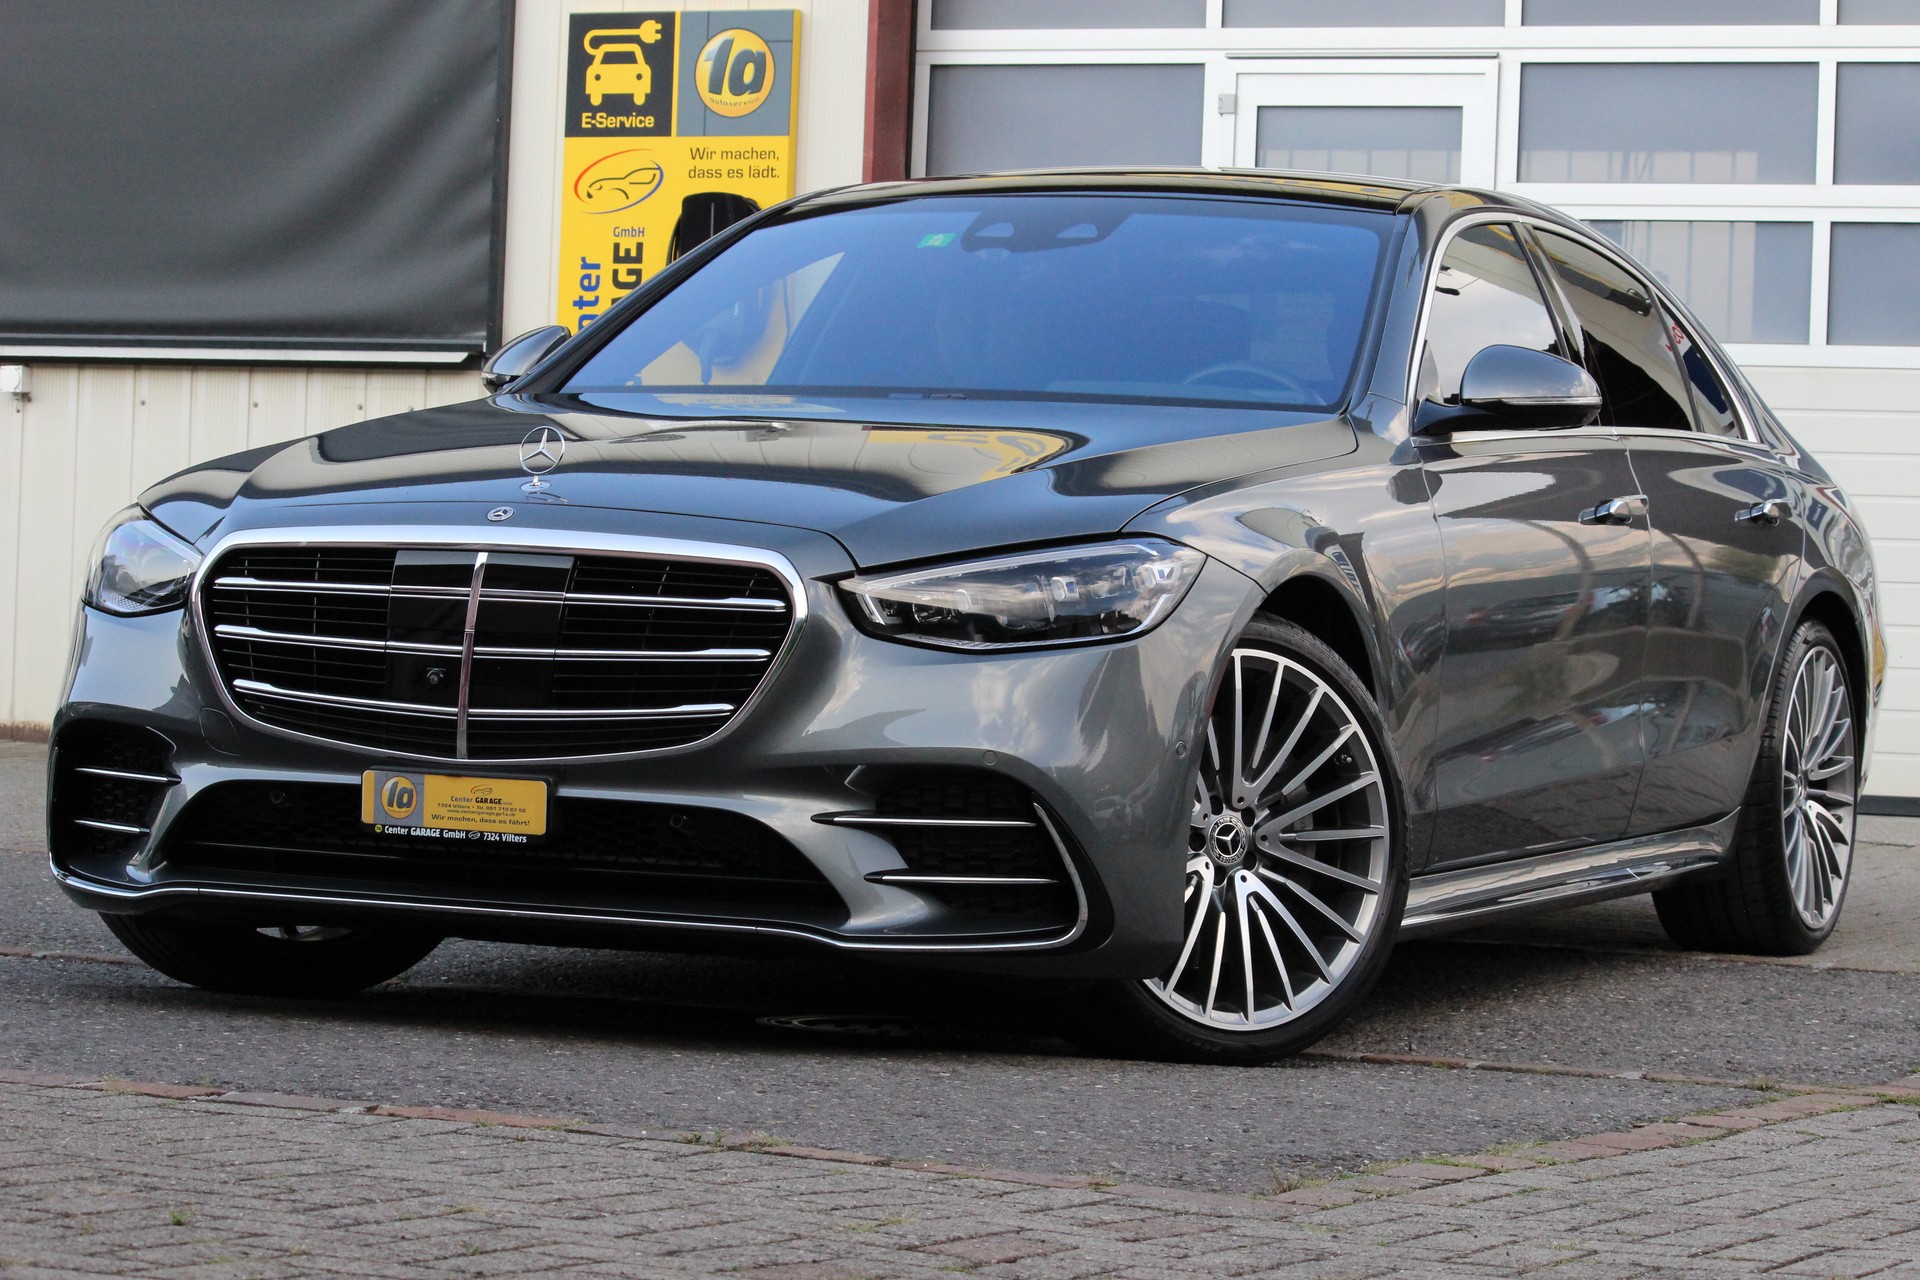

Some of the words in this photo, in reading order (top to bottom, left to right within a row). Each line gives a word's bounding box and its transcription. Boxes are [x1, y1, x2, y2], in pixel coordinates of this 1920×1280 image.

[581, 112, 655, 129] E-Service
[690, 147, 716, 161] Wir
[720, 147, 780, 162] machen,
[688, 165, 722, 179] dass
[727, 168, 743, 178] es
[748, 165, 780, 178] lädt.
[613, 226, 645, 238] GmbH
[431, 813, 446, 821] Wir
[447, 815, 478, 823] machen,
[384, 825, 409, 835] Center
[410, 827, 441, 838] GARAGE
[443, 829, 466, 839] GmbH
[483, 832, 500, 841] 7324
[501, 833, 527, 843] Vilters
